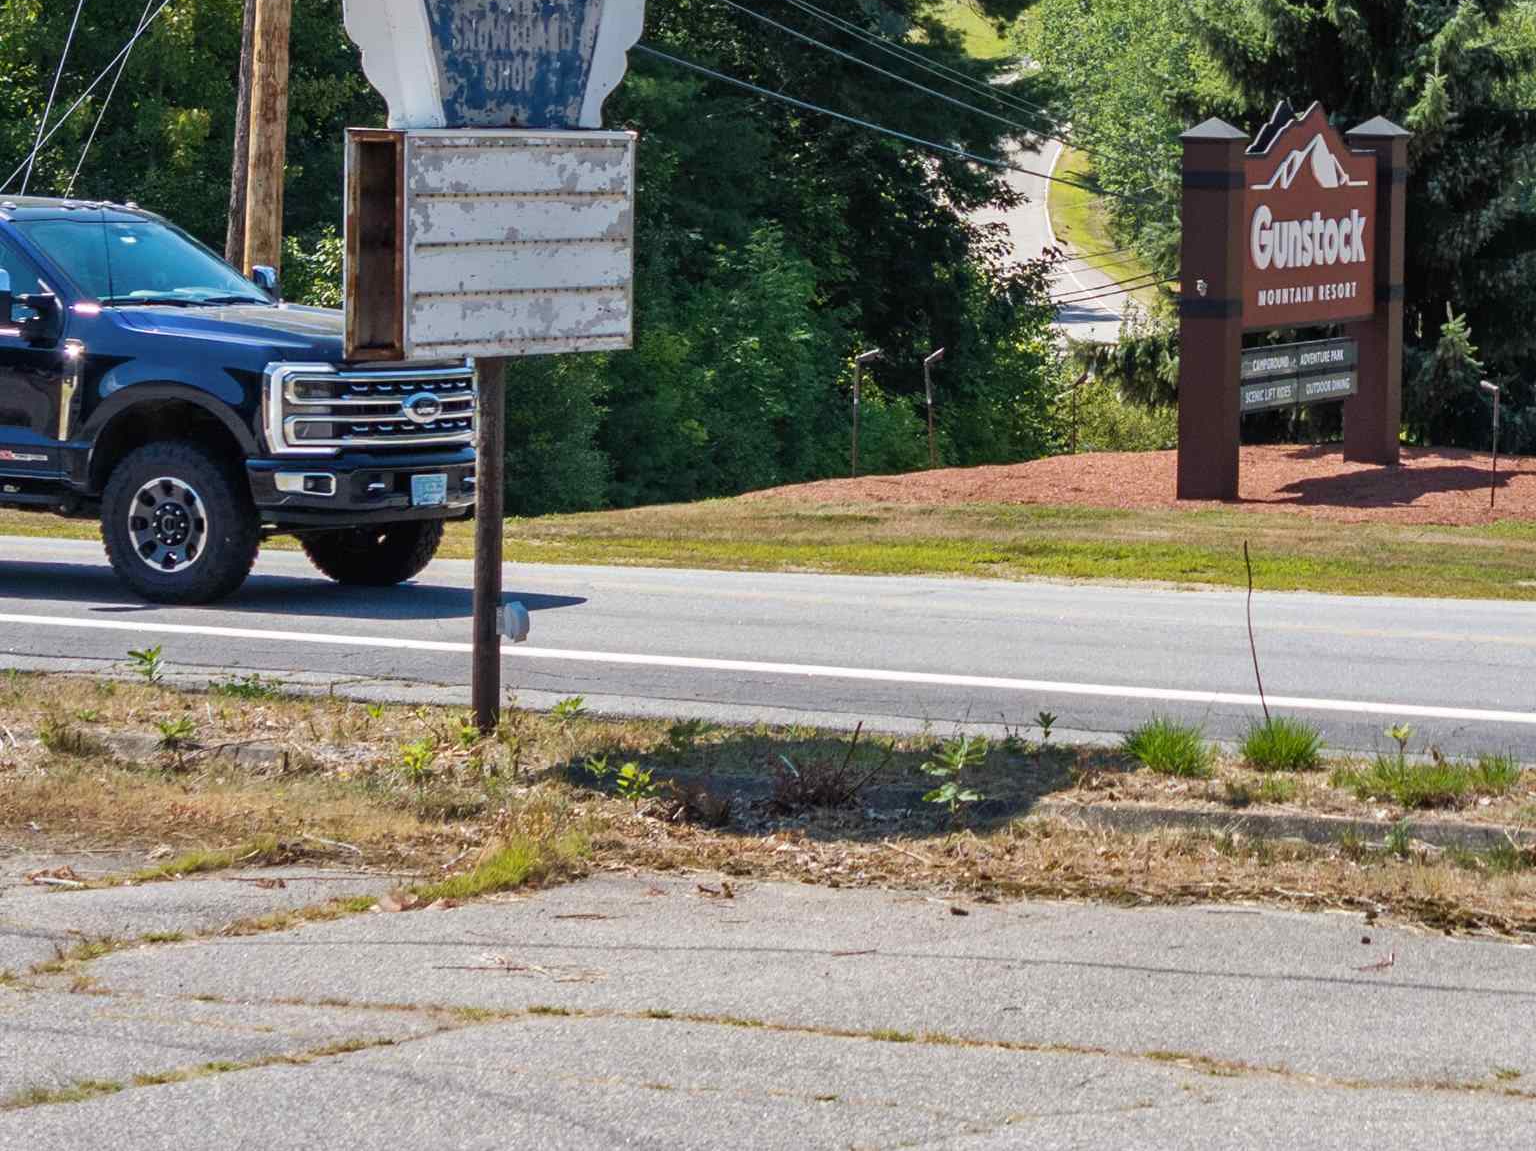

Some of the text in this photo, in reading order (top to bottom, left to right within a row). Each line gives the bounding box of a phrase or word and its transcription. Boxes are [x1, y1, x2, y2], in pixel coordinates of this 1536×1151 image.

[485, 57, 537, 92] SHOP
[1250, 204, 1366, 270] Gunstock
[1258, 281, 1357, 306] MOUNTAIN RESORT
[1300, 349, 1344, 366] ADVENTURE PARK
[1245, 389, 1264, 404] SCENIC
[1264, 387, 1276, 401] LIFT
[1305, 379, 1331, 395] OUTDOOR
